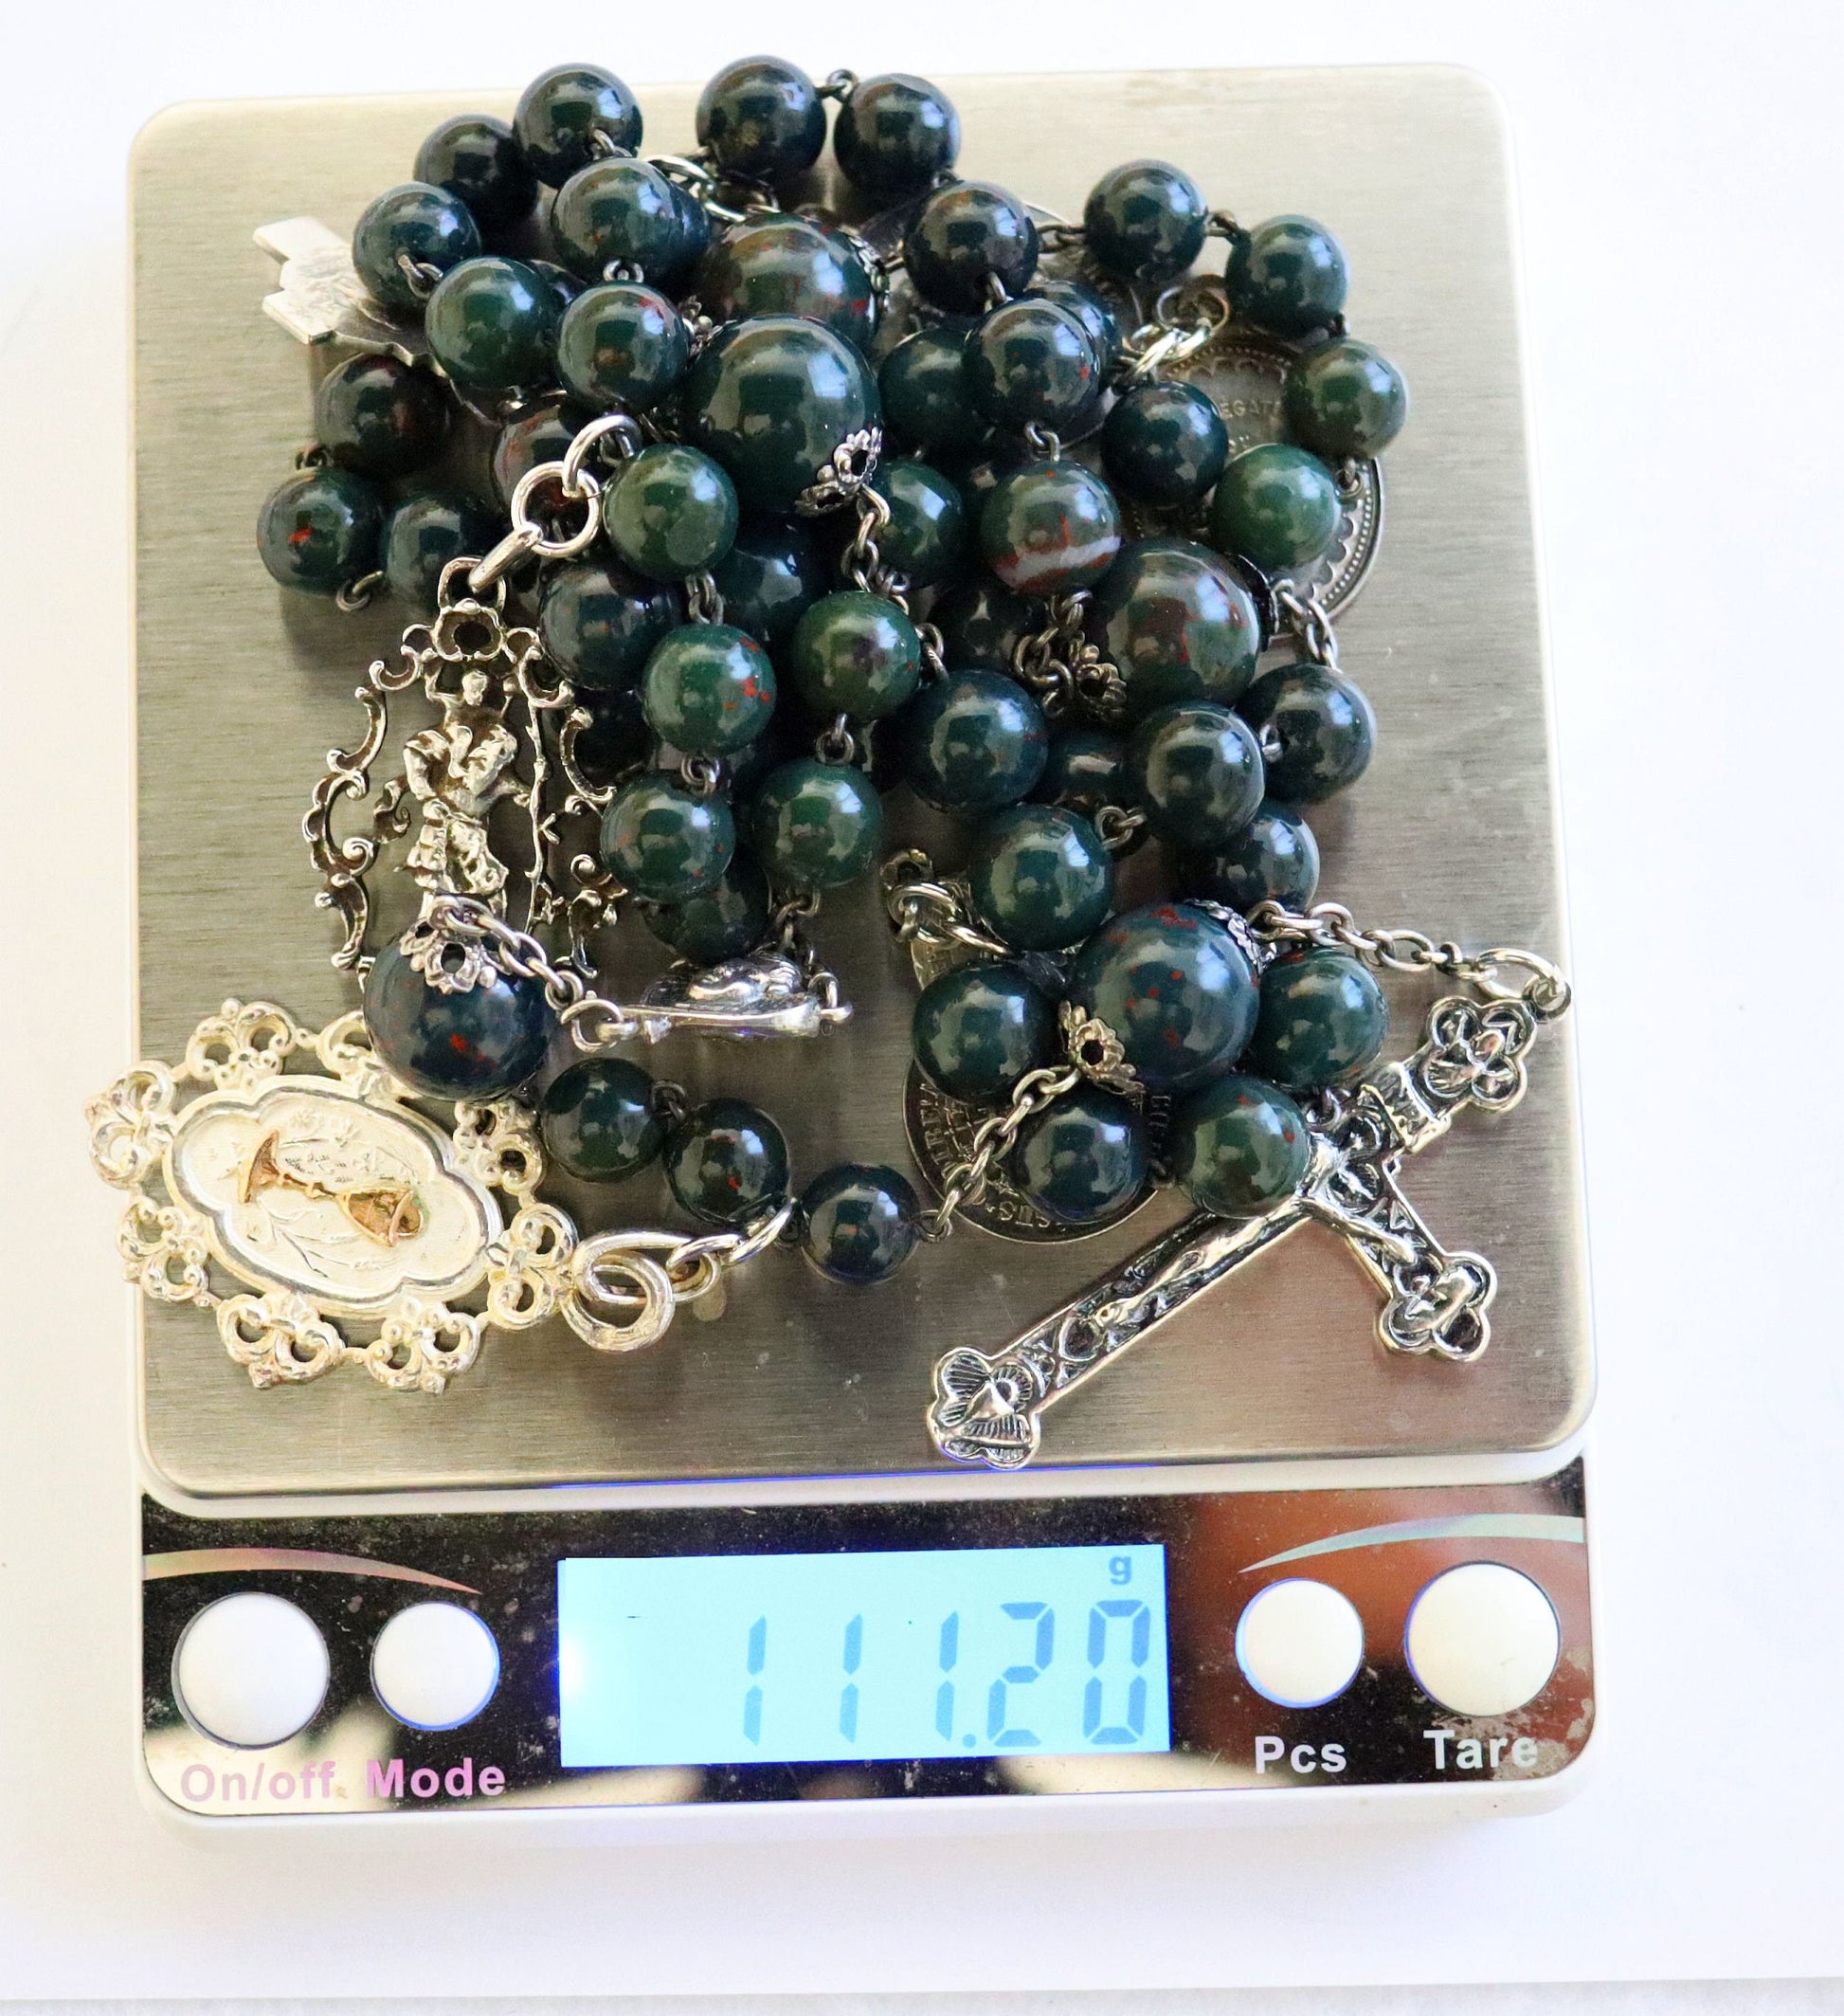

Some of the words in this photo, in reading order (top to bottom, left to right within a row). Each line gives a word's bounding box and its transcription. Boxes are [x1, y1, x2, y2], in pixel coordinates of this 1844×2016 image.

[1109, 1555, 1132, 1585] g
[743, 1600, 1150, 1748] 111.20
[1255, 1735, 1347, 1773] Pcs
[1423, 1729, 1538, 1770] Tare
[180, 1760, 335, 1802] On/off
[366, 1757, 506, 1799] Mode
